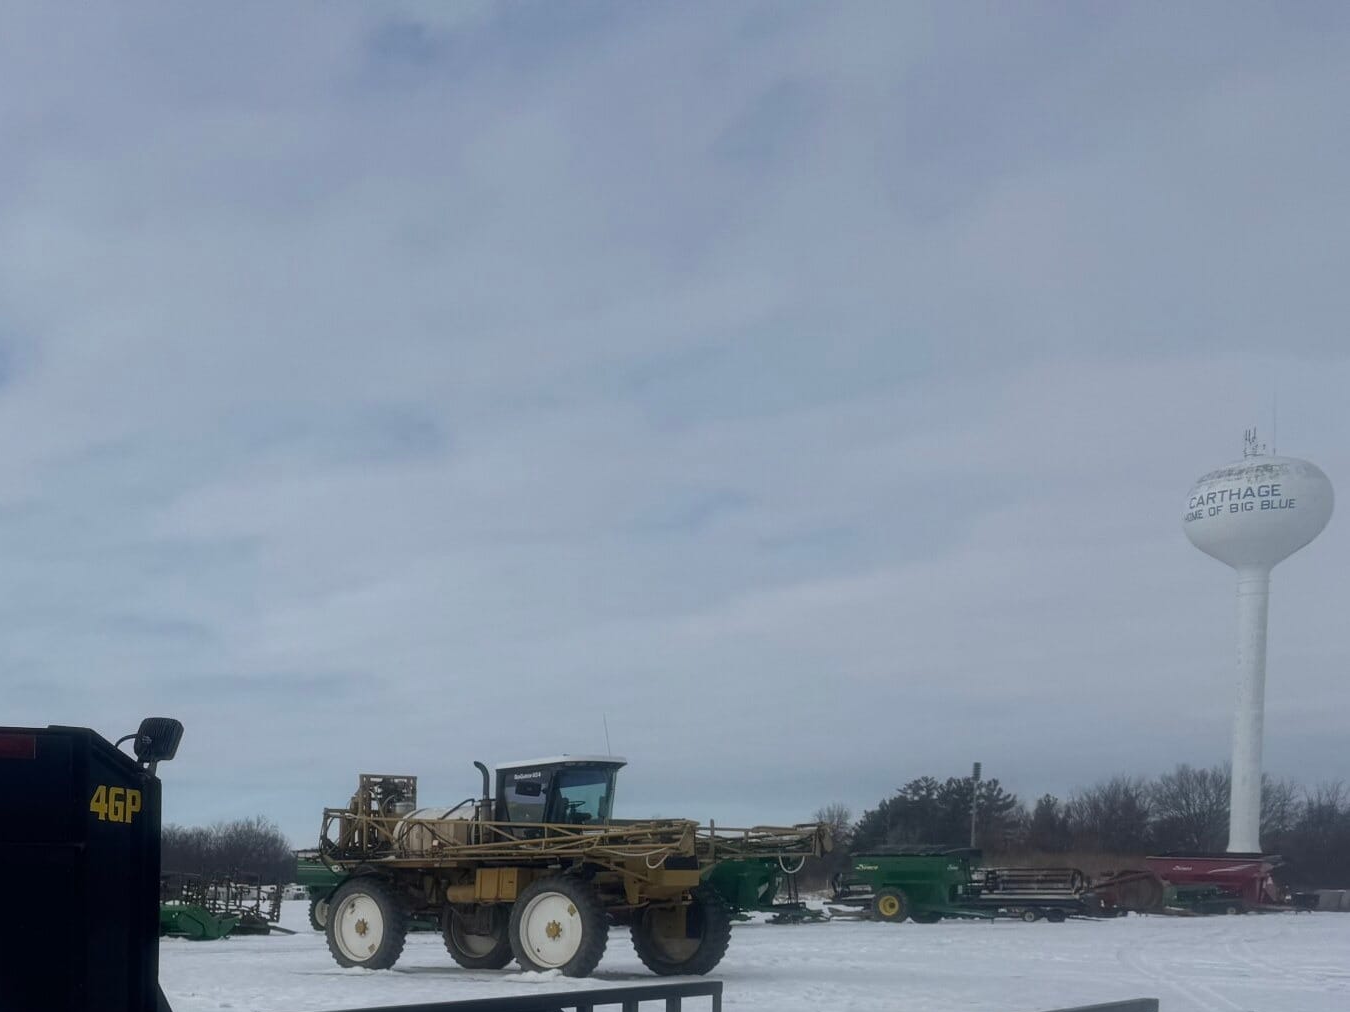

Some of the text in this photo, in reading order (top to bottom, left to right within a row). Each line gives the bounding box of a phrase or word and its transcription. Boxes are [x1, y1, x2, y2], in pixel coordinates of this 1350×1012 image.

[1189, 483, 1282, 509] CARTHAGE
[1208, 505, 1223, 517] OF
[1230, 501, 1254, 513] BIG
[1261, 498, 1296, 510] BLUE
[90, 785, 141, 823] 4GP
